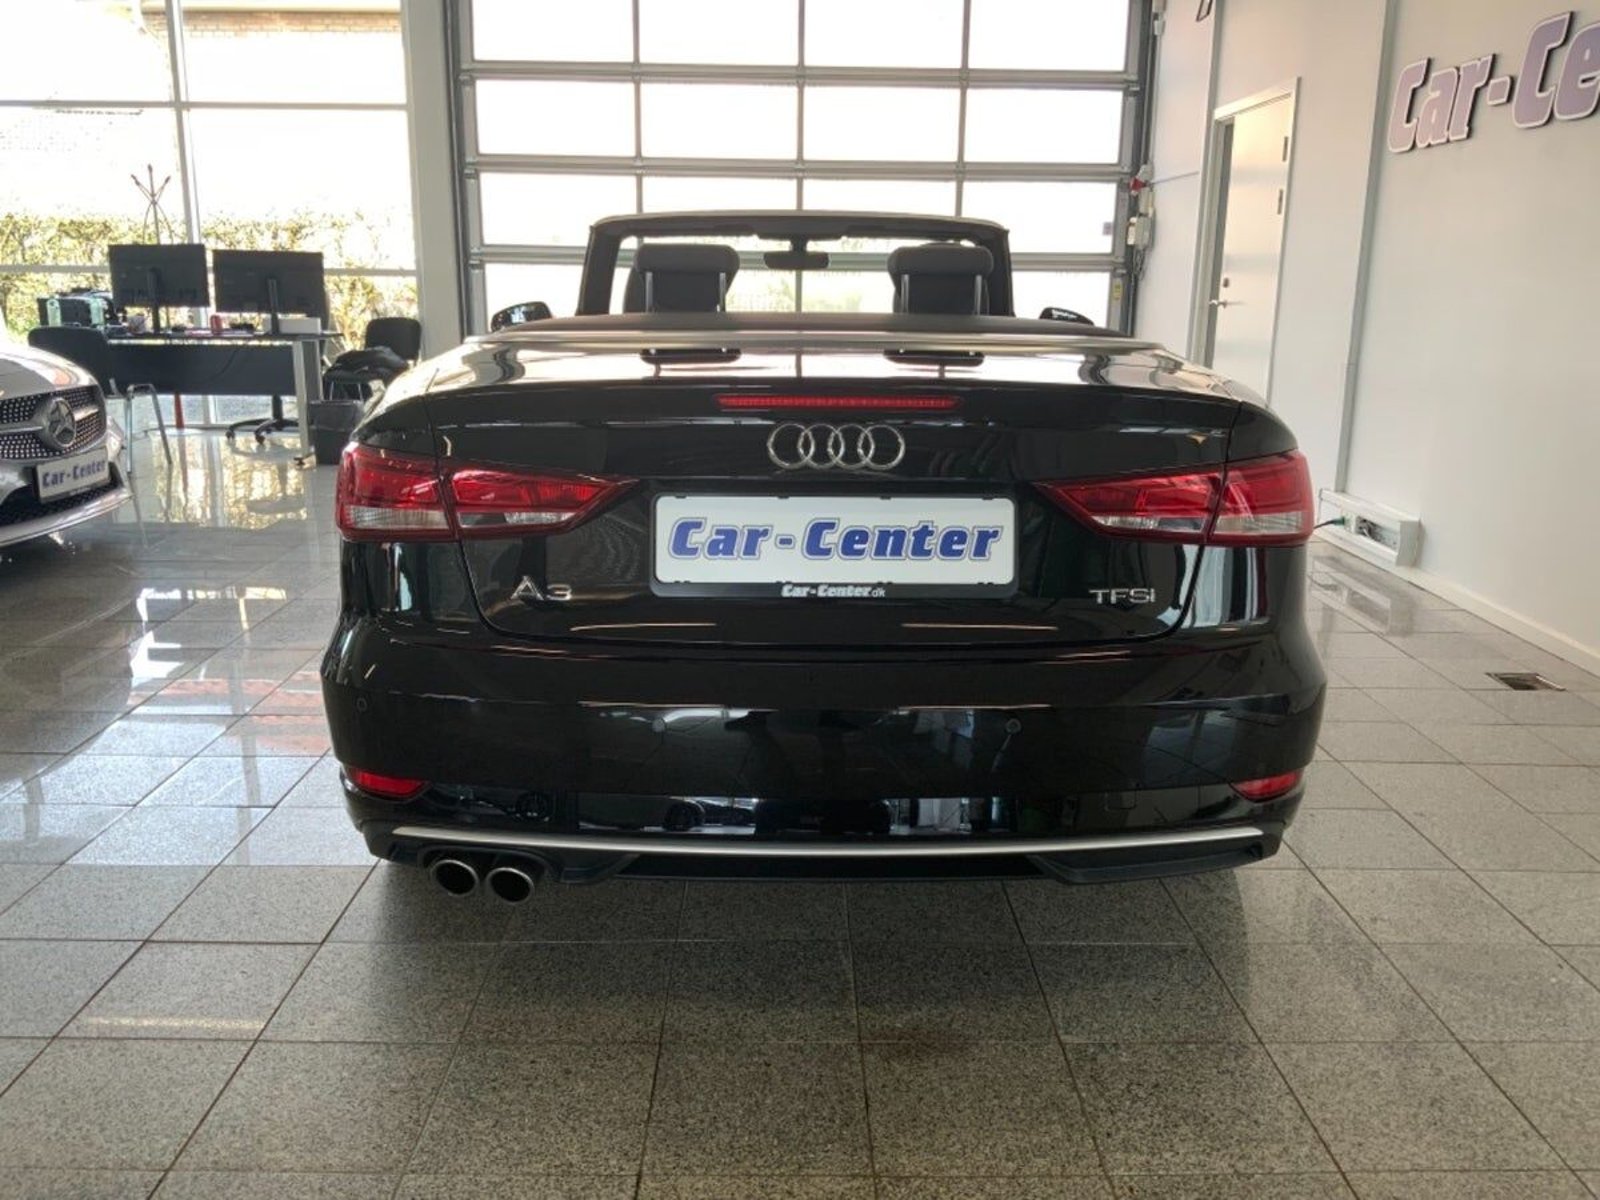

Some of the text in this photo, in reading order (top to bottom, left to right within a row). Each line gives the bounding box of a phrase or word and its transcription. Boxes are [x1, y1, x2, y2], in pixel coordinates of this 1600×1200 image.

[668, 517, 1004, 561] Car-Center
[510, 575, 572, 601] A3
[1088, 588, 1155, 604] TFSI
